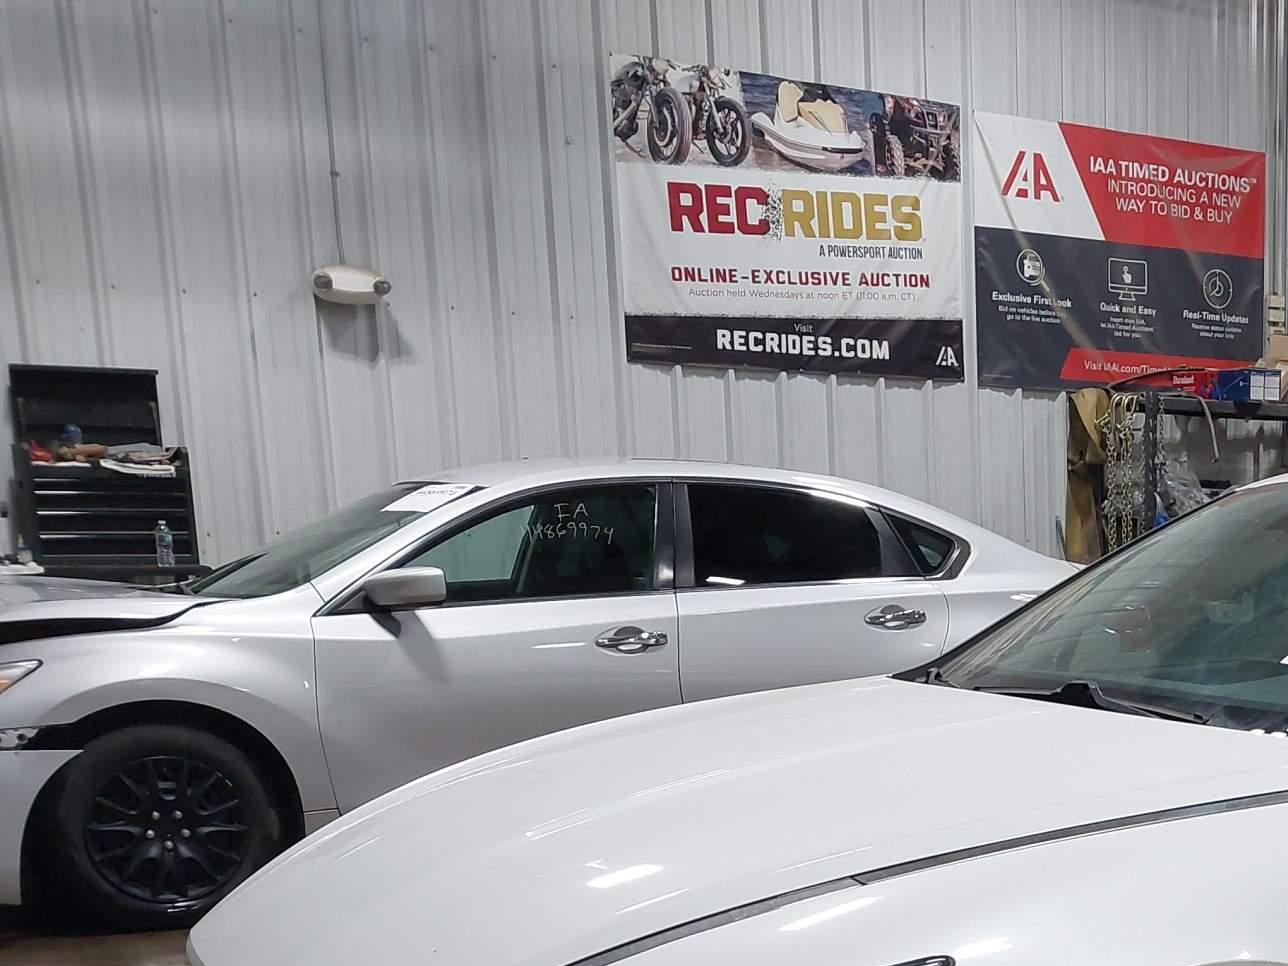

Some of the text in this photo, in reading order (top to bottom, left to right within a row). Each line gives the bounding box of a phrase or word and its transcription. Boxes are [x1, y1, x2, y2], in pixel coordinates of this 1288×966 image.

[1089, 155, 1116, 176] IAA
[1119, 160, 1169, 182] TIMED
[1108, 178, 1241, 209] INTRODUCING A NEW
[1116, 196, 1233, 224] WAY TO BID & BUY
[819, 244, 923, 260] A POWERSPORT AUCTION
[671, 266, 930, 288] ONLINE-EXCLUSIVE AUCTION
[689, 288, 724, 298] Auction
[726, 288, 746, 298] held
[748, 289, 803, 301] Wednesdays
[806, 290, 815, 299] at
[818, 292, 839, 300] noon
[842, 292, 853, 300] ET
[881, 293, 898, 301] a.m.
[900, 292, 916, 302] CT)
[992, 291, 1032, 304] Exclusive
[1033, 295, 1052, 306] First
[1100, 302, 1157, 318] Quick and Easy
[1183, 309, 1249, 324] Real-Time Updates
[793, 322, 814, 333] Visit
[716, 328, 890, 360] RECRIDES.COM
[1084, 360, 1101, 370] Visit
